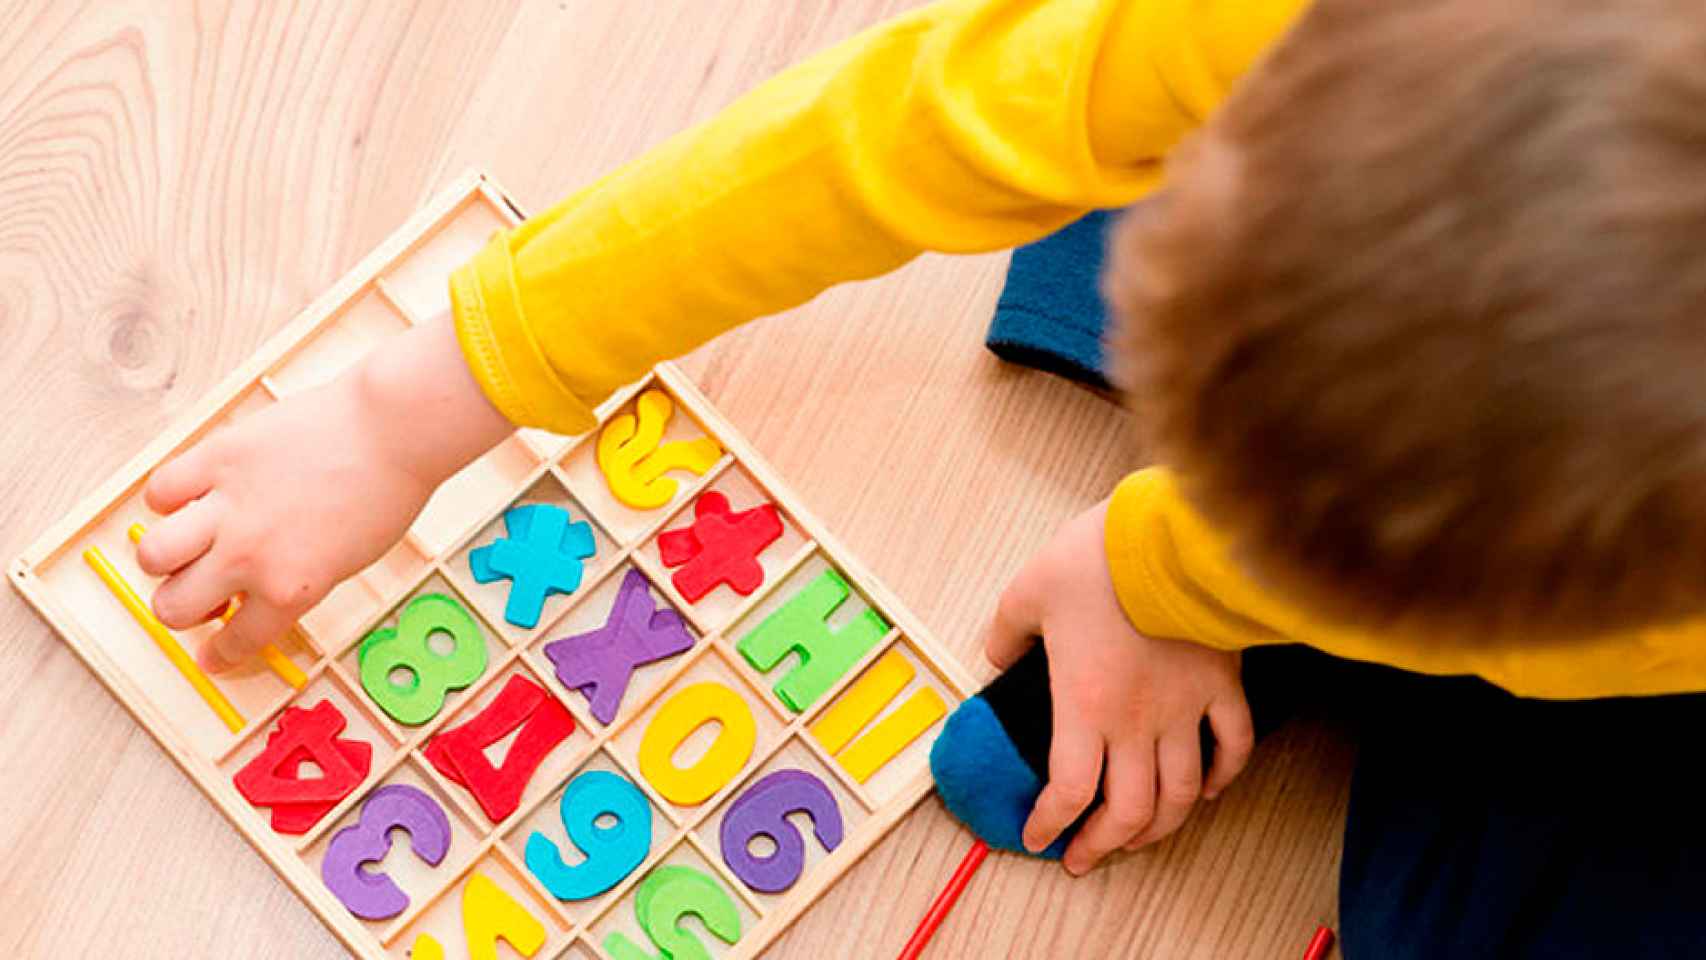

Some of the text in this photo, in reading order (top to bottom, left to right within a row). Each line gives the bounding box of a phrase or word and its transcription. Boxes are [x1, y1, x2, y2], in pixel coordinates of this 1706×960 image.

[358, 593, 488, 726] 8
[322, 784, 452, 921] 3
[525, 770, 653, 902] 6
